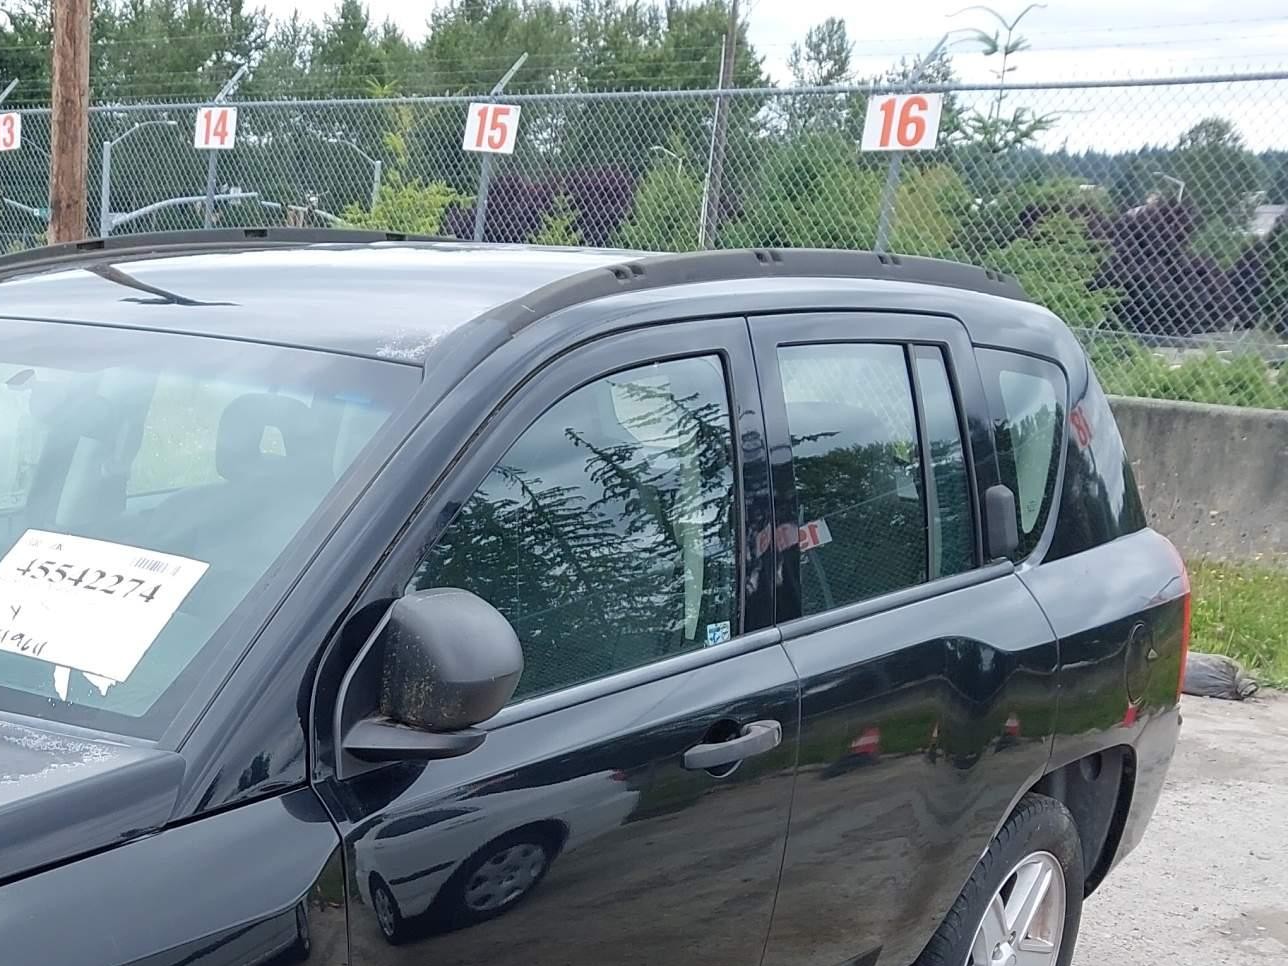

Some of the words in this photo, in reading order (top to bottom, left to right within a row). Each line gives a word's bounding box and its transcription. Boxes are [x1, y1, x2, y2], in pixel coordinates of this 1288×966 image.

[204, 110, 228, 145] 14
[475, 106, 510, 149] 15
[879, 95, 928, 147] 16
[16, 558, 162, 603] 45542274
